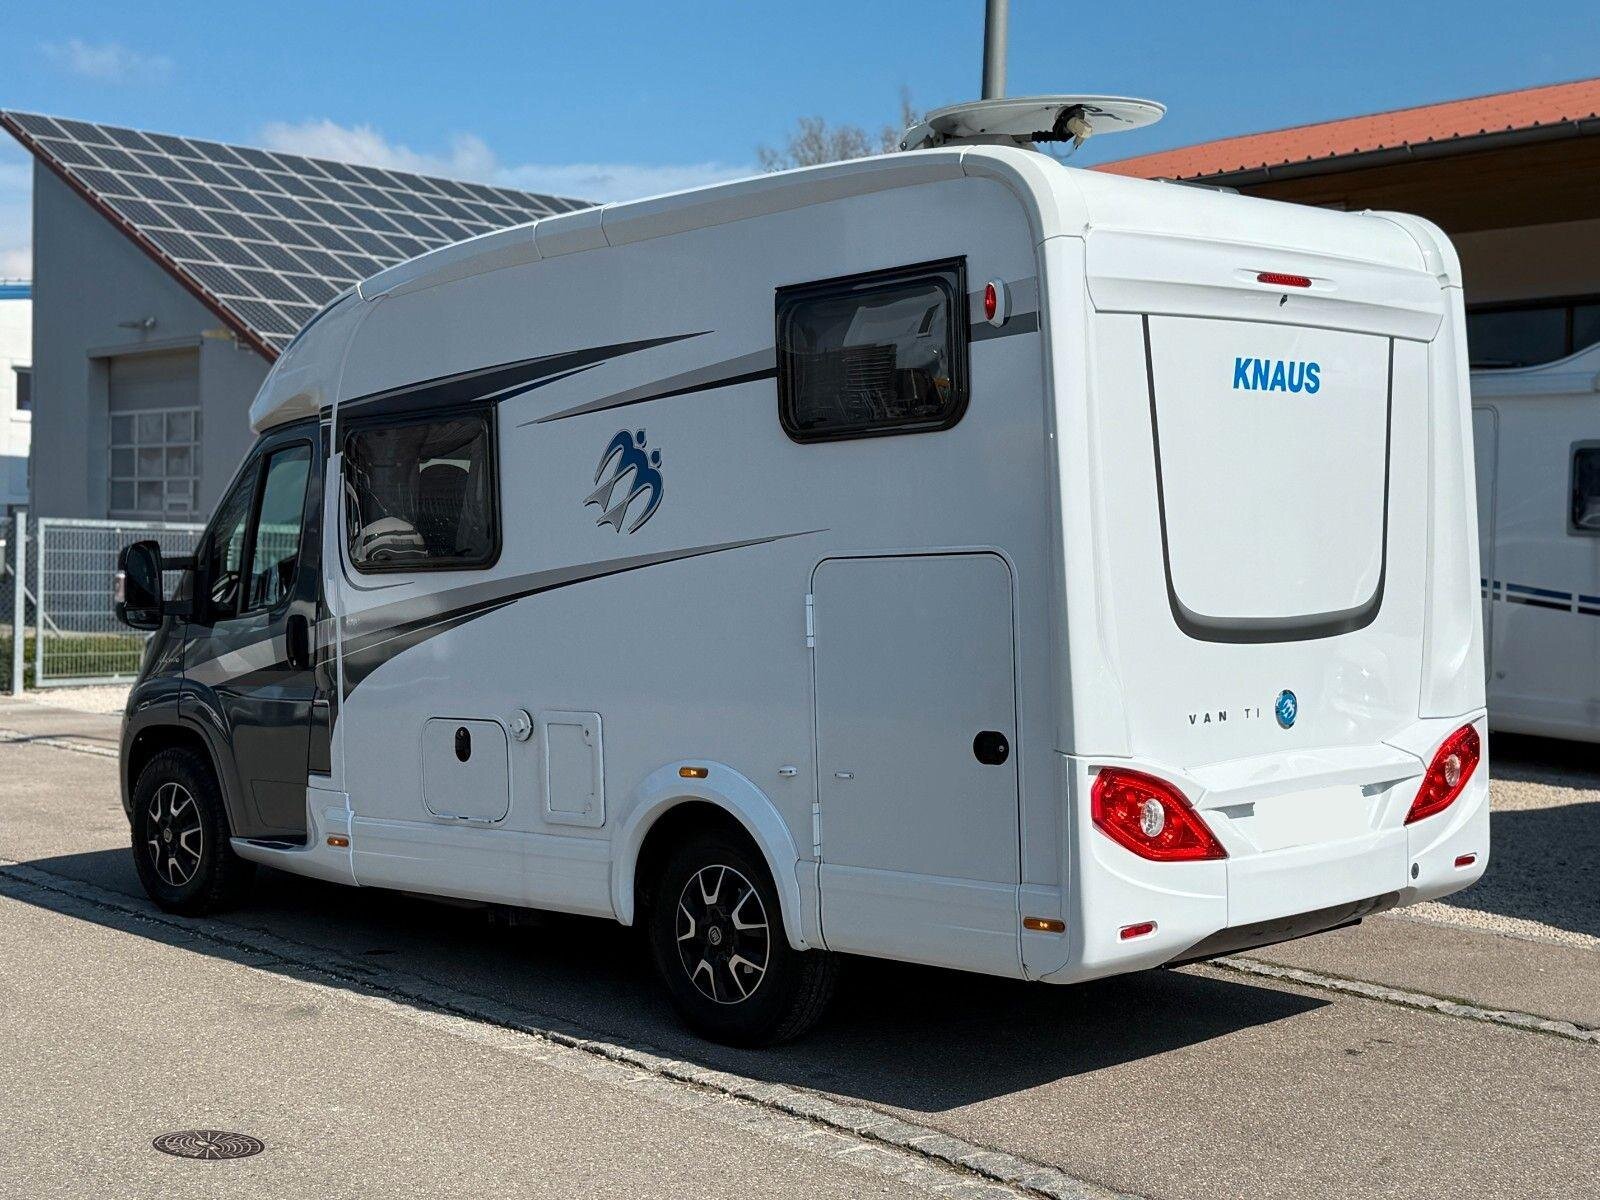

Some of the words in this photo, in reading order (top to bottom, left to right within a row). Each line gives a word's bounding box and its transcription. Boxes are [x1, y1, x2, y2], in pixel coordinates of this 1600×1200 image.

[1233, 357, 1320, 394] KNAUS
[1189, 711, 1227, 725] VAN
[1244, 708, 1260, 719] TI
